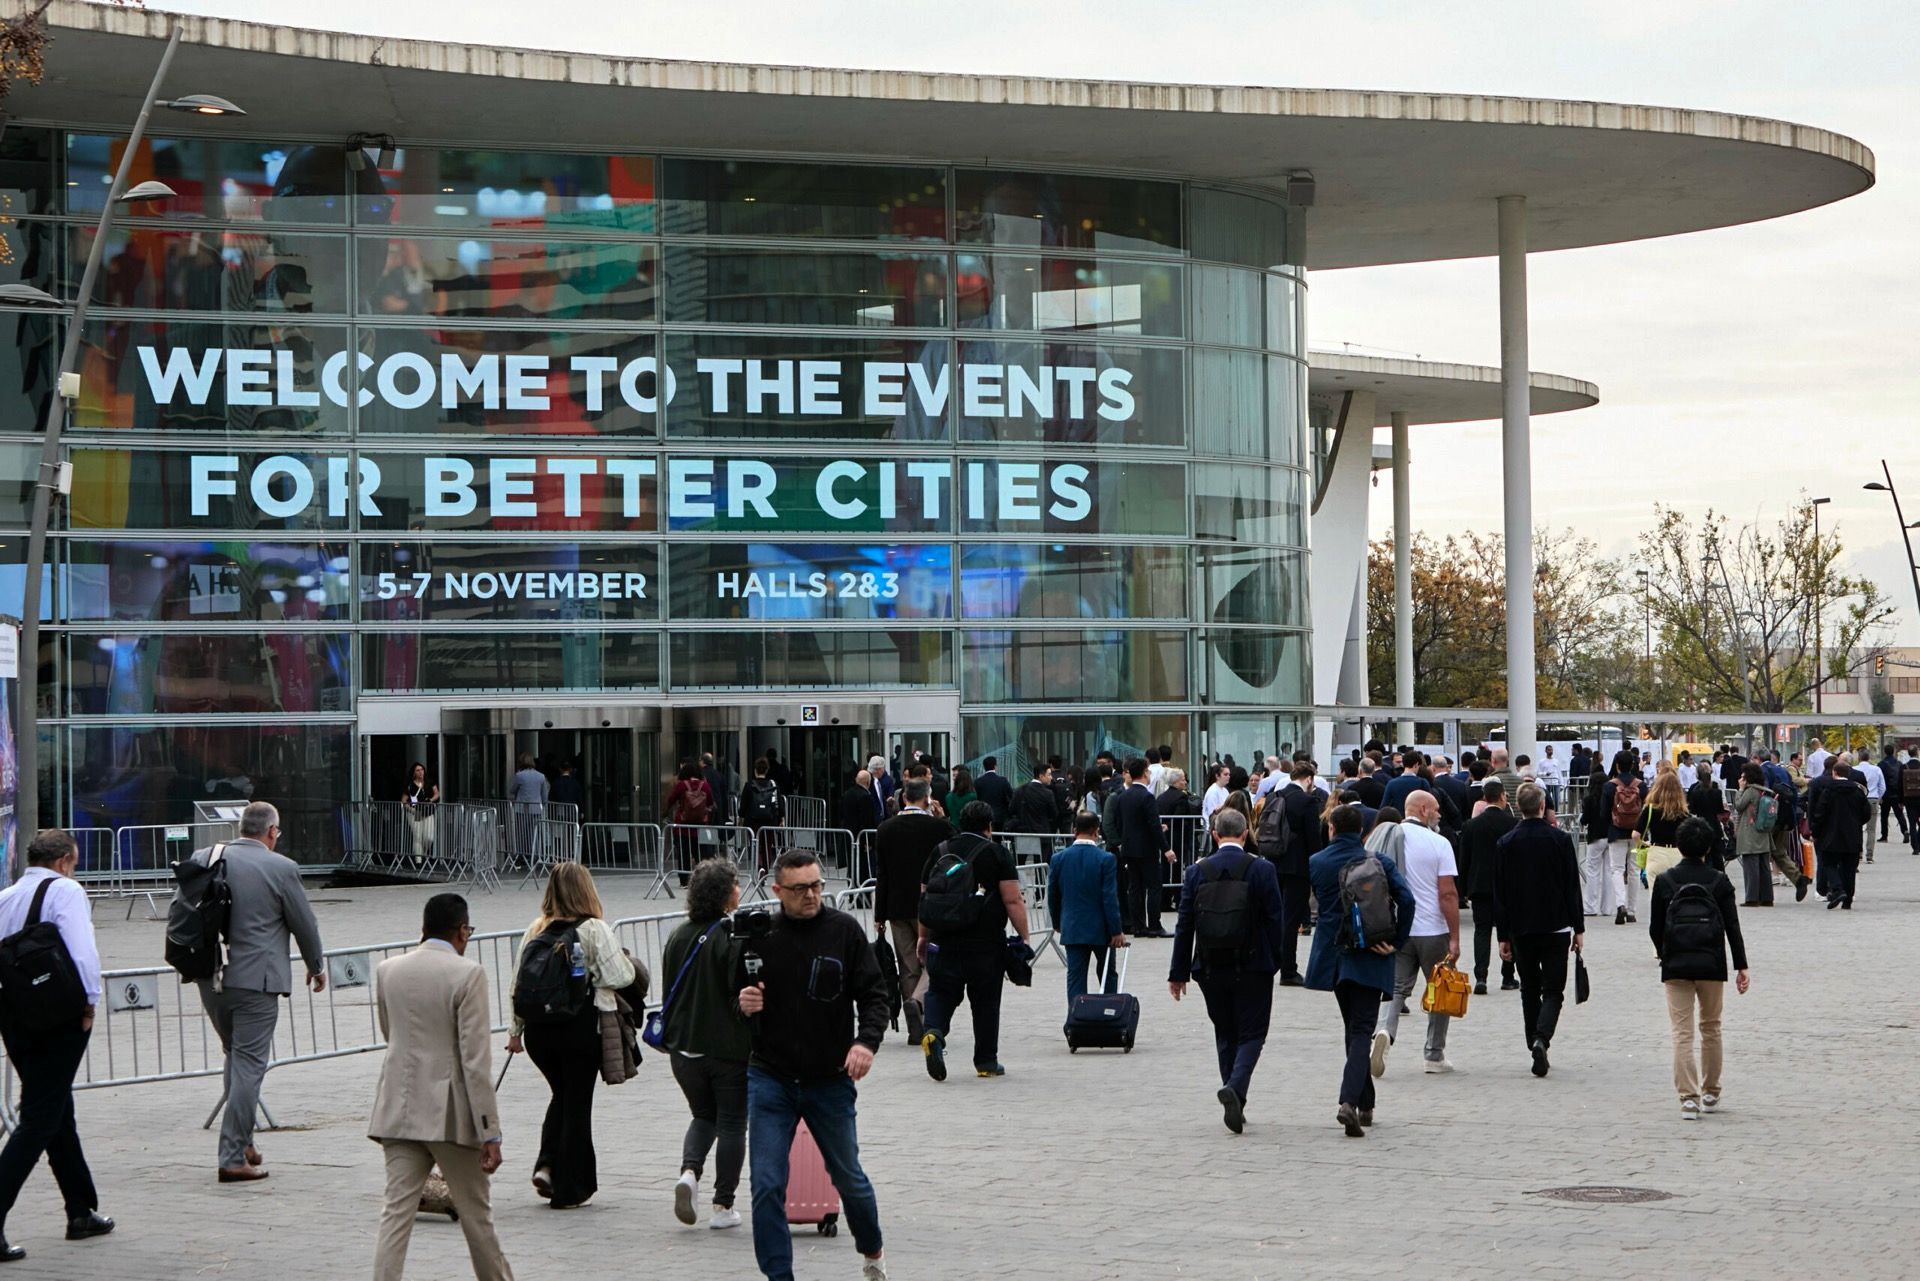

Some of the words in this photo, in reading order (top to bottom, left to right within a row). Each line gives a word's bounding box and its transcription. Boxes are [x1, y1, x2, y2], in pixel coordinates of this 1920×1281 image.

[138, 347, 549, 409] WELCOME
[571, 357, 676, 412] TO
[698, 359, 841, 414] THE
[865, 363, 1134, 421] EVENTS
[192, 456, 382, 517] FOR
[425, 458, 777, 517] BETTER
[816, 461, 1091, 520] CITIES
[378, 573, 431, 598] 5-7
[446, 573, 645, 598] NOVEMBER
[719, 573, 826, 598] HALLS
[839, 573, 898, 597] 2&3
